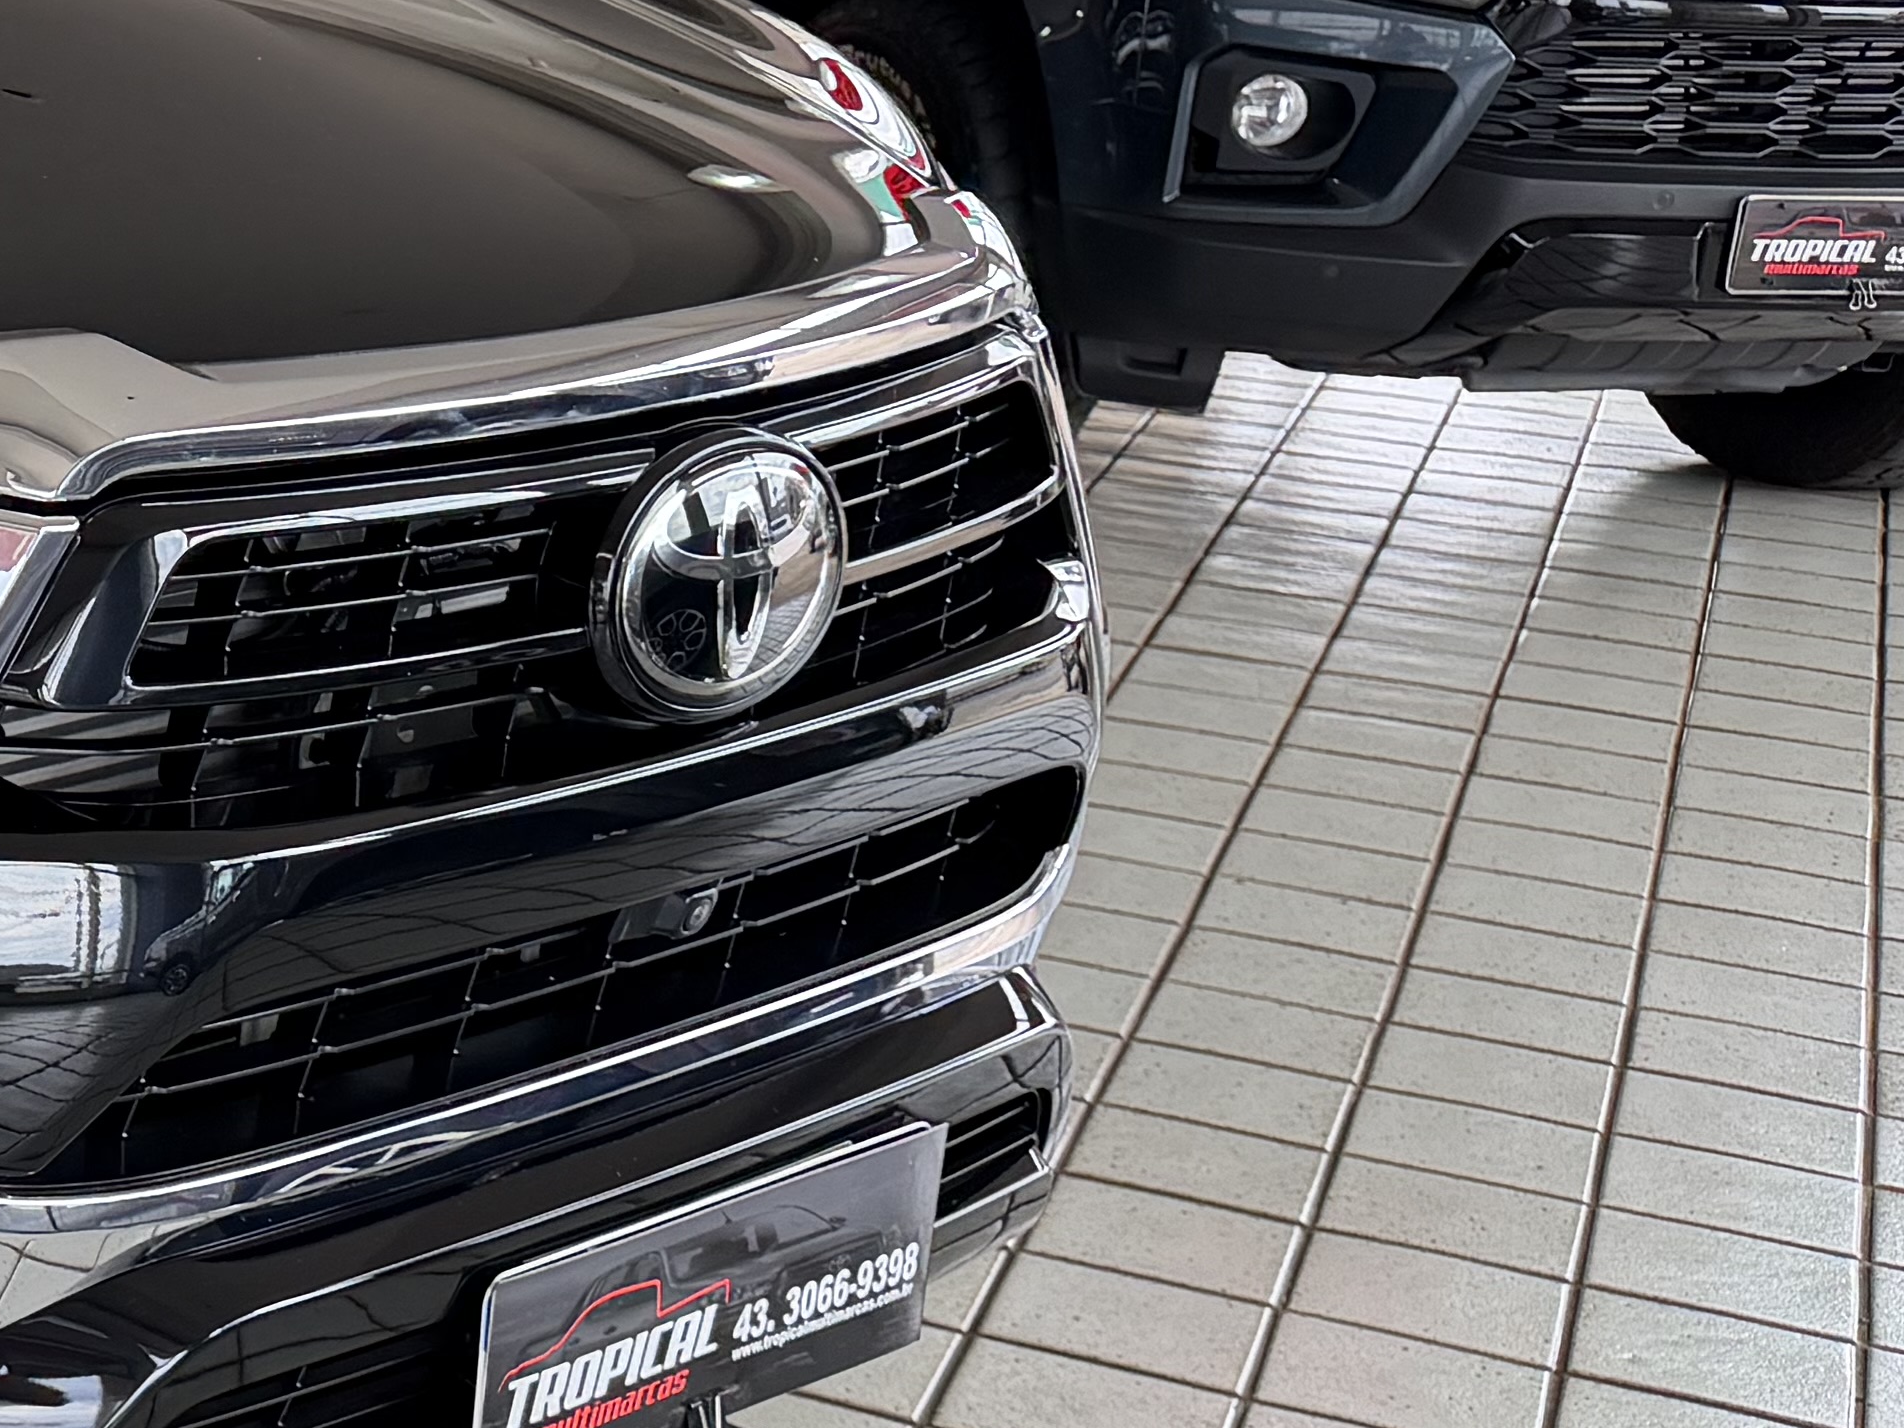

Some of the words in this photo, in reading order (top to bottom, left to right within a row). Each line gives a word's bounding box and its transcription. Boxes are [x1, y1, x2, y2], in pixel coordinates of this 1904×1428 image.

[1750, 239, 1877, 264] TROPICAL
[732, 1298, 776, 1342] 43.
[782, 1242, 920, 1325] 3066-9398
